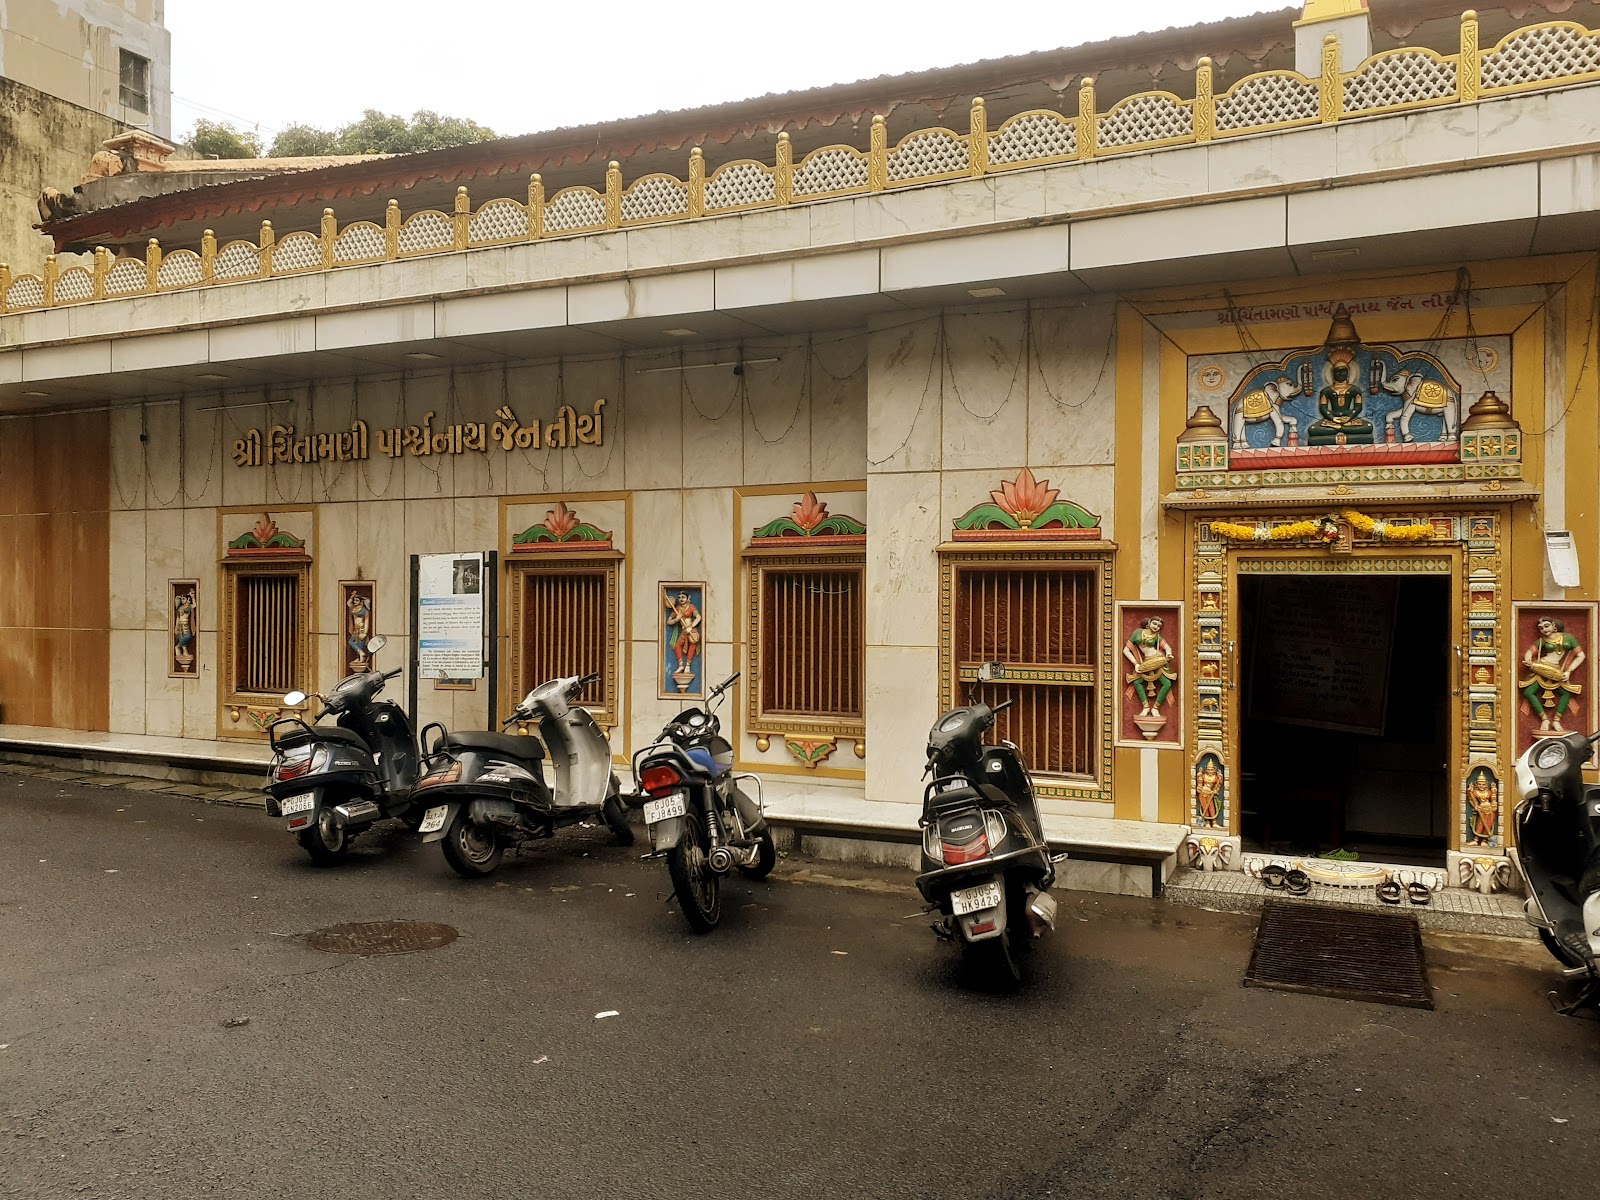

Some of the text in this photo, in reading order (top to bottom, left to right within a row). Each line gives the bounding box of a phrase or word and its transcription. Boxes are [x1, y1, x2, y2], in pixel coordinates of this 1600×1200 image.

[231, 428, 261, 466] શ્રી
[267, 420, 369, 465] ચિંતામણી
[491, 405, 540, 451] જૈન
[544, 398, 606, 447] તીર્થ
[654, 797, 676, 810] GJ05
[650, 805, 683, 821] FJ8499
[950, 824, 973, 833] SUZUKI
[965, 886, 991, 900] GJ05
[961, 894, 999, 913] HK9428
